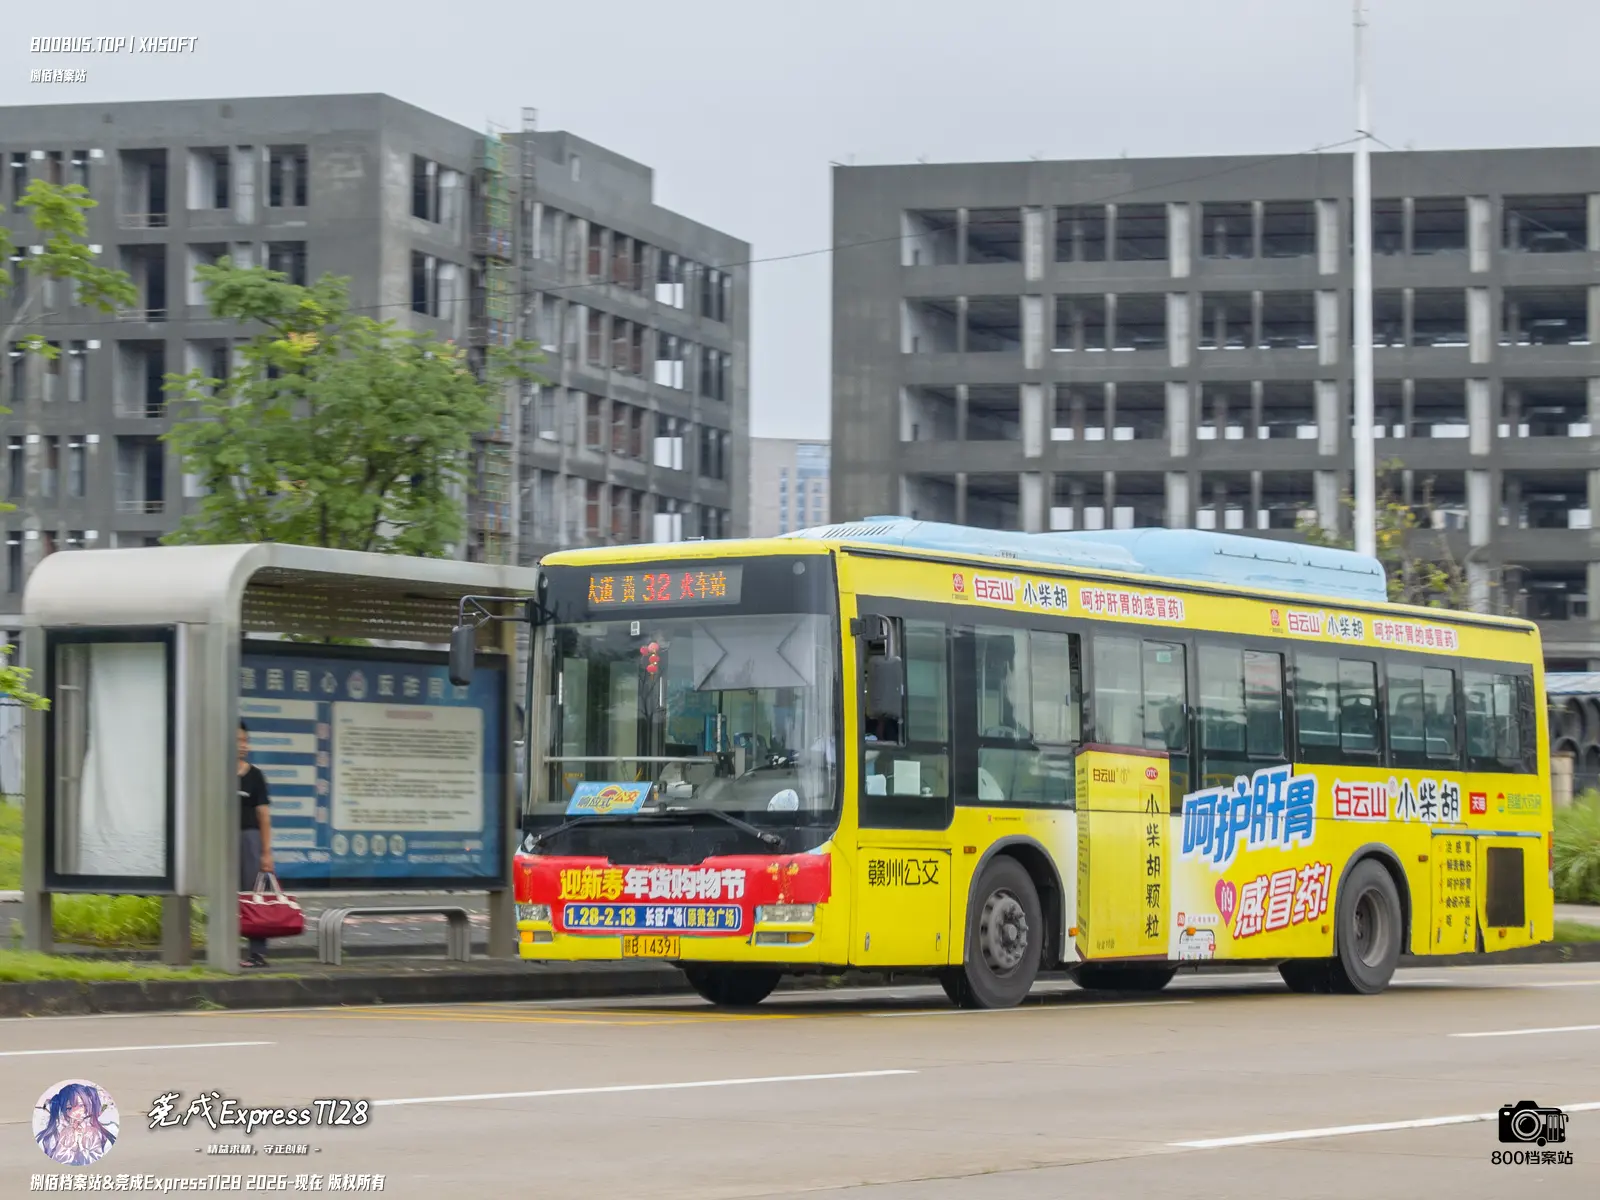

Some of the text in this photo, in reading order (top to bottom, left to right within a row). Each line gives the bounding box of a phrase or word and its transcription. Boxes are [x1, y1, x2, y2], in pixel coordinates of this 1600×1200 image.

[642, 573, 671, 602] 32
[680, 571, 726, 599] 火车站
[974, 577, 1014, 602] 白云山
[1023, 582, 1068, 609] 小柴胡
[1287, 612, 1321, 633] 白云山
[1327, 616, 1363, 638] 小柴胡
[1092, 768, 1158, 783] 白云山 OTC
[1182, 771, 1315, 863] 呵护肝胃
[1334, 782, 1459, 821] 白云山 小柴胡
[868, 858, 939, 886] 赣州公交
[1145, 793, 1160, 939] 小柴胡颗粒
[558, 866, 746, 900] 迎新春年货购物节
[1221, 861, 1332, 939] 的 感冒药!
[566, 907, 636, 926] 1.28-2.13
